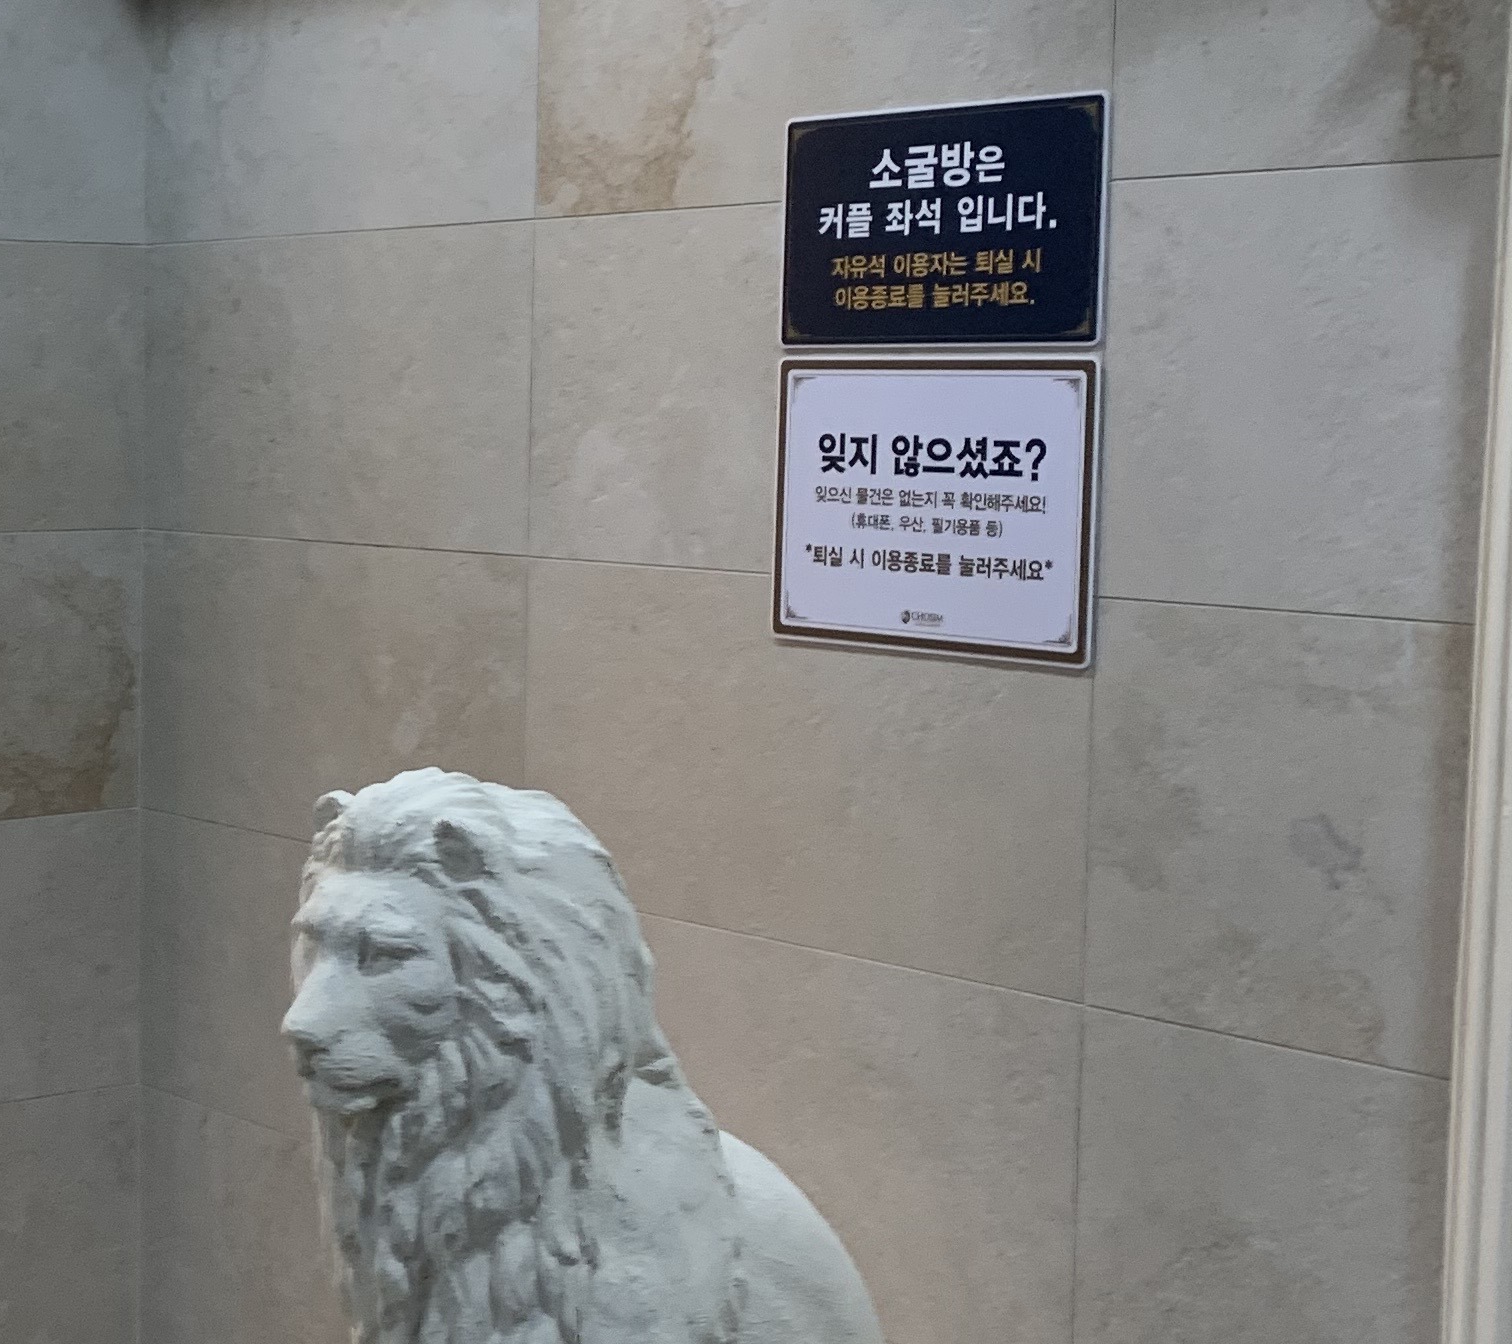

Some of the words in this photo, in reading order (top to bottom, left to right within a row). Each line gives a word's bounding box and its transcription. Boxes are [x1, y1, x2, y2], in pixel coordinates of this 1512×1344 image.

[869, 141, 1005, 189] 소굴방은
[818, 203, 873, 239] 커플
[885, 197, 941, 236] 좌석
[957, 191, 1057, 233] 입니다.
[832, 255, 885, 279] 자유석
[893, 252, 967, 277] 이용자는
[975, 249, 1013, 274] 퇴실
[1022, 247, 1042, 273] 시
[835, 283, 925, 310] 이용종료를
[818, 432, 878, 475] 잊지
[891, 435, 1047, 481] 않으셨죠?
[855, 487, 895, 506] 물건은
[898, 489, 938, 508] 없는지
[941, 491, 956, 509] 꼭
[931, 517, 980, 536] 필기용품
[985, 520, 1003, 538] 등)
[849, 548, 865, 569] 시
[871, 549, 952, 575] 이용종료를
